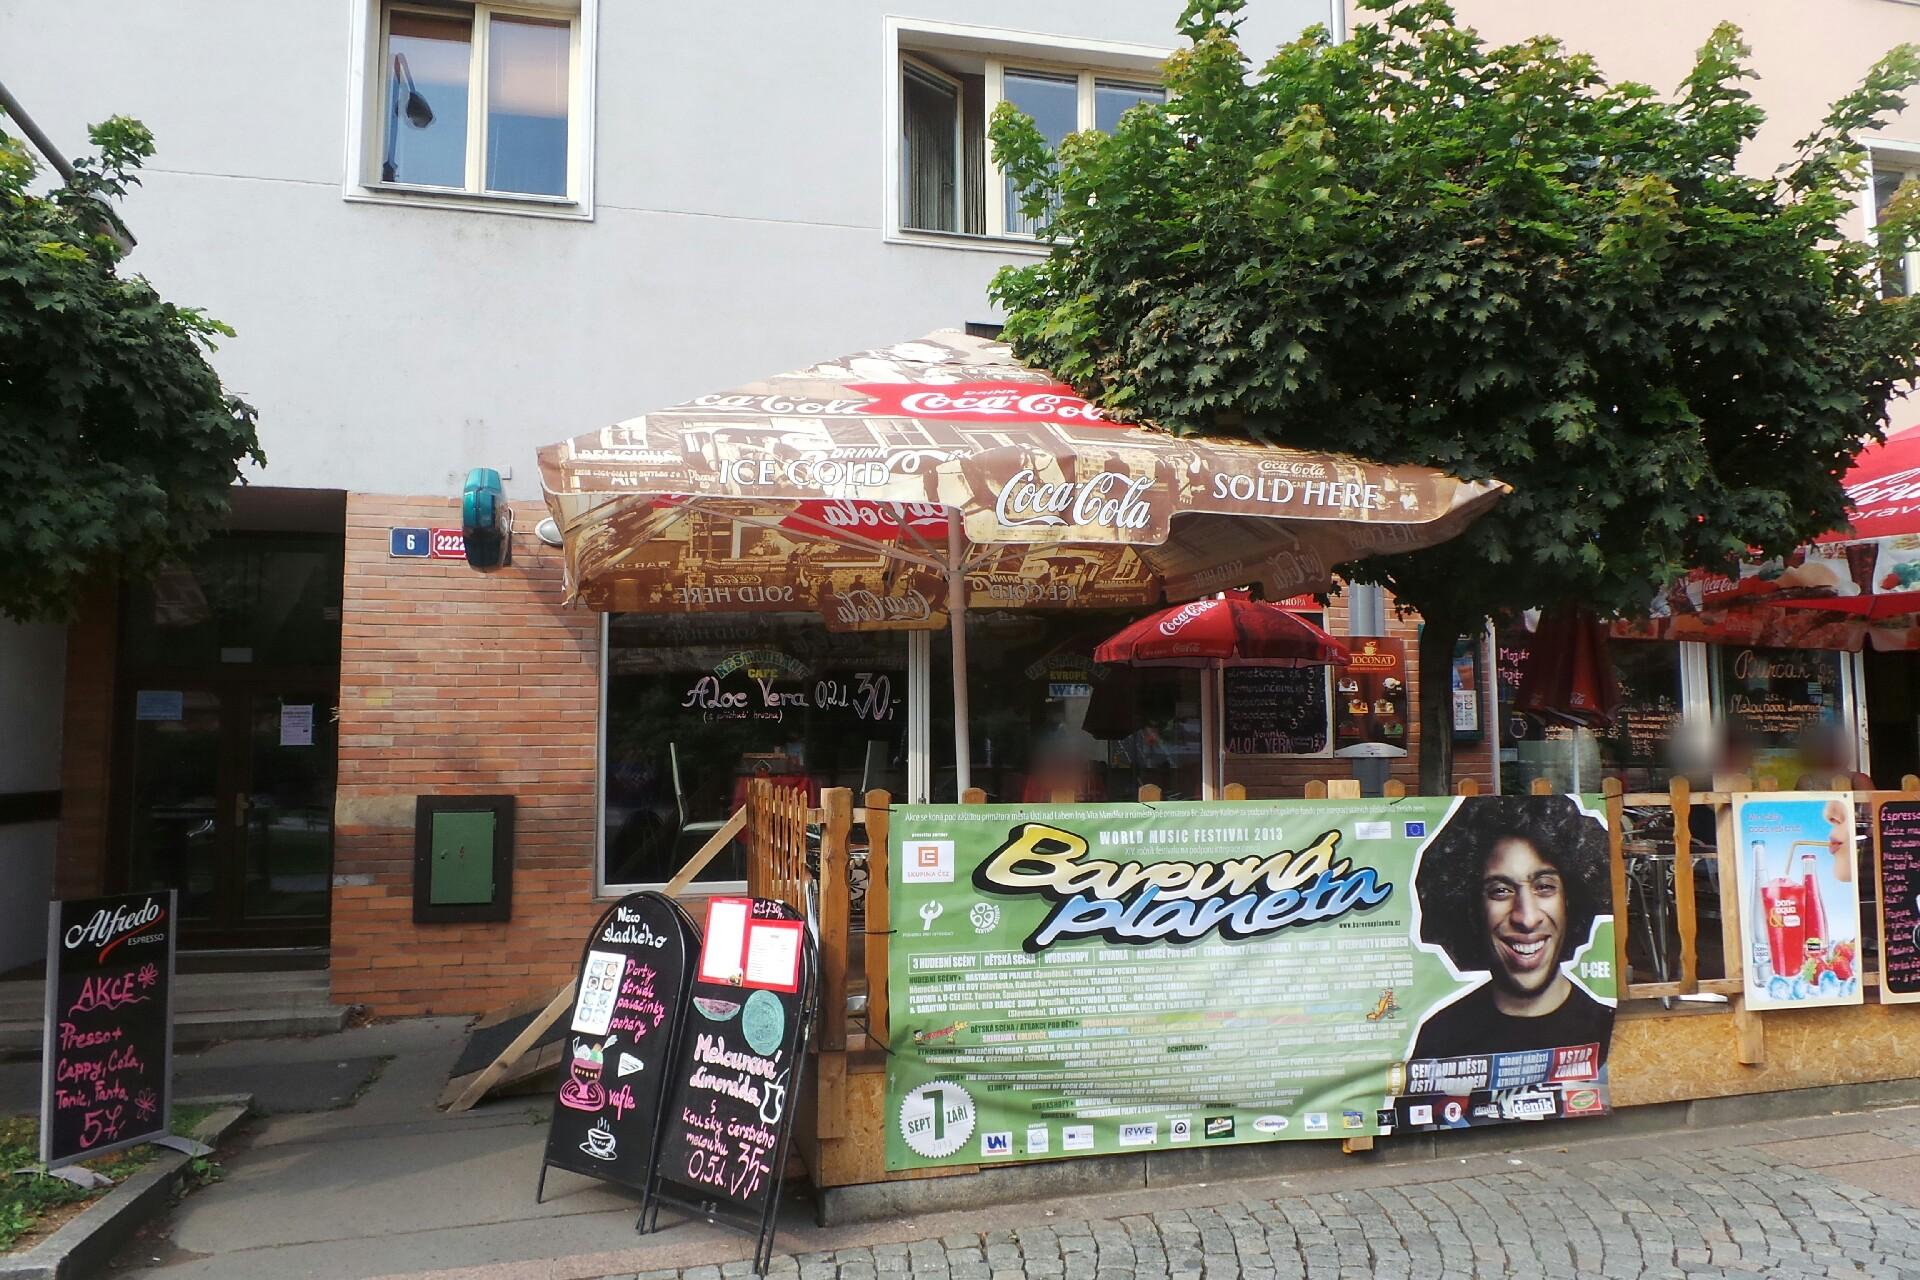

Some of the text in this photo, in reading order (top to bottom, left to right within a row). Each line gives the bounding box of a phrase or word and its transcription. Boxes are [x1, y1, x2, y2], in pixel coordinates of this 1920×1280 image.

[900, 392, 1104, 421] Coca-Col
[718, 458, 776, 486] ICE
[786, 459, 890, 487] COLD
[995, 468, 1157, 529] Coca-Cola
[1212, 473, 1379, 510] SOLD HERE
[406, 534, 415, 550] 6
[681, 675, 748, 710] Aloe
[757, 676, 810, 709] Vera
[1099, 826, 1284, 846] WORLD MUSIC FESTIVAL 2013
[972, 822, 1353, 901] Barevná
[616, 907, 641, 924] Něco
[1022, 867, 1394, 953] planeta
[64, 897, 160, 950] Alfredo
[127, 933, 165, 947] ESPRESSO
[602, 921, 668, 949] sladkého
[912, 954, 976, 970] 3 HUDEBNÍ SCÉNY
[984, 952, 1012, 967] DĚTSKÁ
[1044, 951, 1090, 964] WORKSHOPY
[1099, 949, 1129, 961] DIVADLA
[625, 959, 657, 982] Dorty
[1580, 960, 1611, 979] U-CEE
[78, 971, 135, 1006] AKCE
[693, 1033, 782, 1081] Melounová
[1559, 1047, 1593, 1065] VSTUP
[1411, 1060, 1458, 1080] CENTRUM
[1458, 1058, 1488, 1075] MĚSTA
[1555, 1061, 1592, 1078] ZDARMA
[1410, 1078, 1434, 1094] ÚSTÍ
[907, 1089, 968, 1141] SEPT 1 ZÁŘÍ
[1514, 1097, 1553, 1114] deník
[727, 1115, 776, 1148] čerstvého
[1124, 1125, 1153, 1136] RWE
